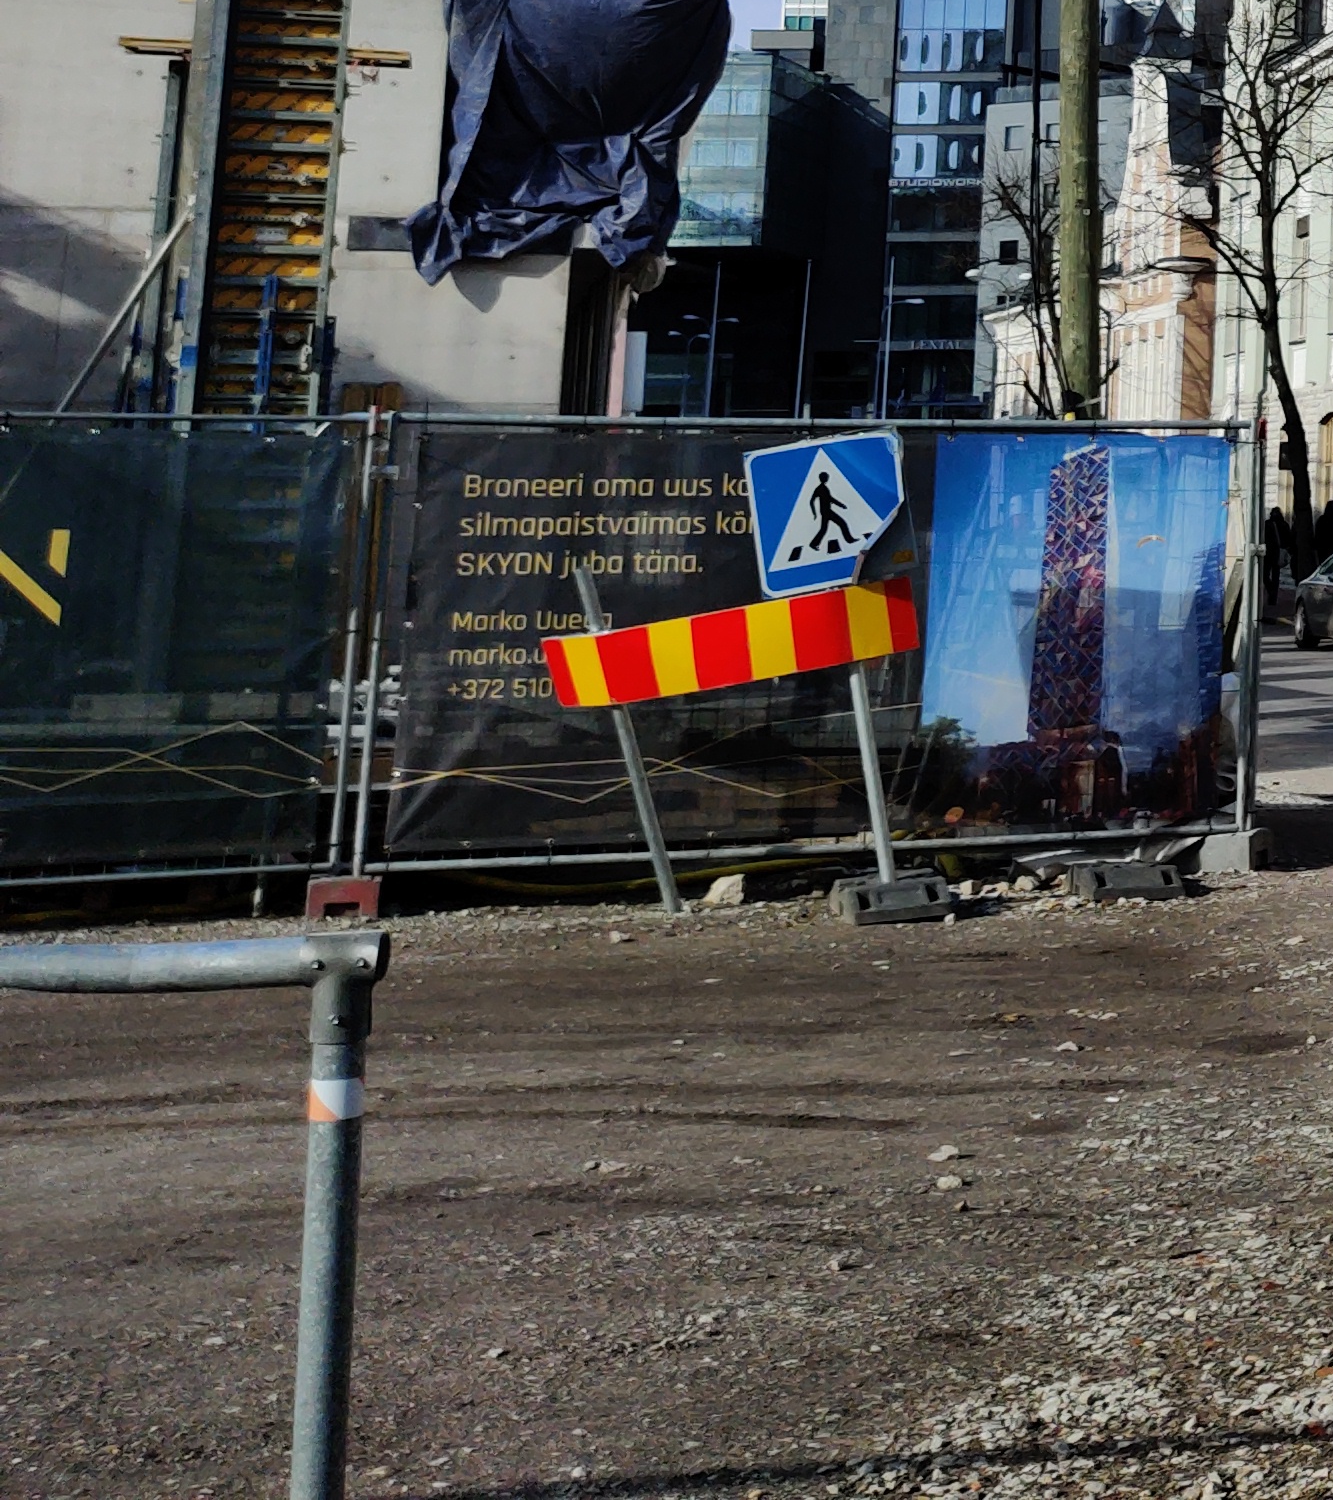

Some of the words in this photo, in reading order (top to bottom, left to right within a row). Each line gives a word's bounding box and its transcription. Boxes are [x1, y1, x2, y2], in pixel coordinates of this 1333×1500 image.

[463, 472, 585, 498] Broneeri
[593, 478, 655, 497] oma
[663, 479, 713, 497] uus
[459, 510, 707, 540] silmapaistvaimas
[456, 551, 553, 576] SKYON
[558, 550, 624, 580] juba
[633, 549, 704, 574] täna.
[452, 610, 527, 632] Marko
[447, 678, 505, 700] +372
[513, 677, 553, 698] 510
